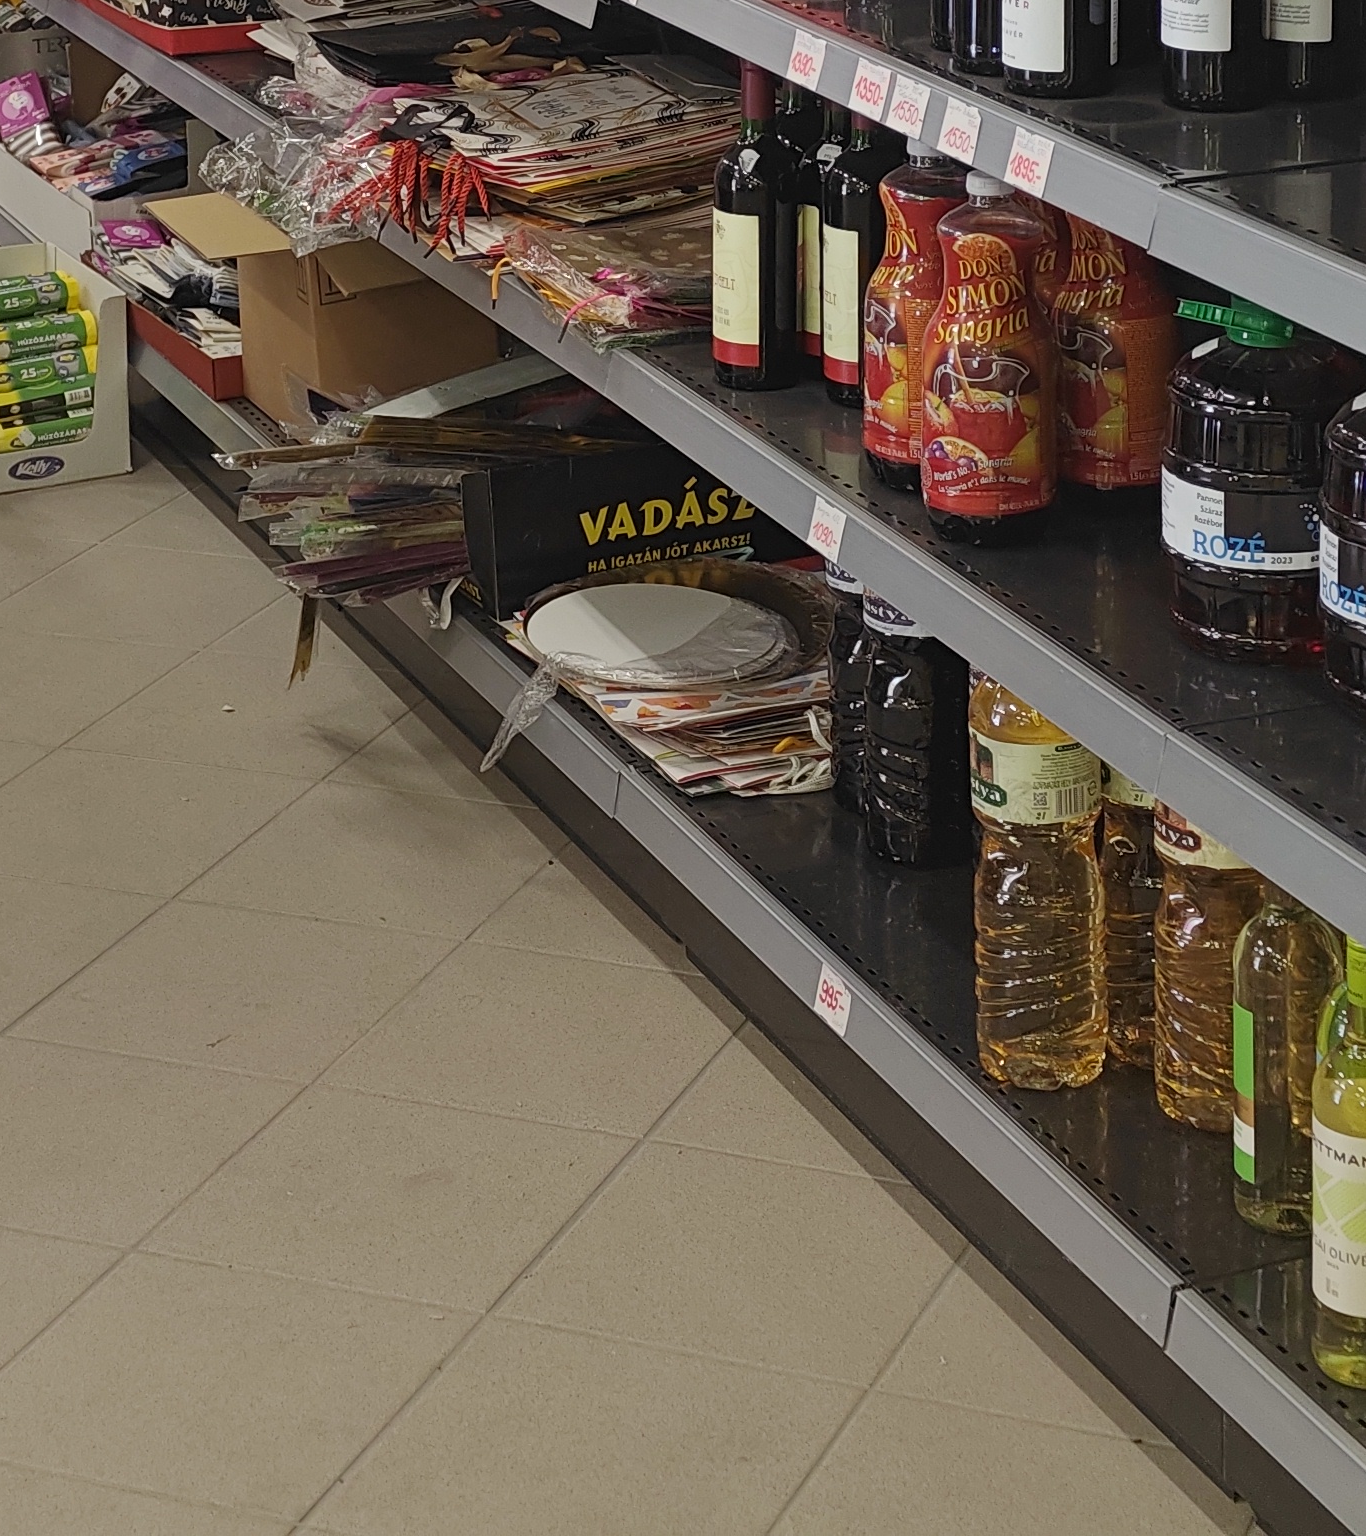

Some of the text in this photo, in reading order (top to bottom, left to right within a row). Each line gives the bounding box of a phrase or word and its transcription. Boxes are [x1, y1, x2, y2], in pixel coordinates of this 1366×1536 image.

[959, 257, 1004, 280] DON
[3, 297, 20, 308] 25
[946, 269, 1027, 316] SIMON
[20, 367, 36, 379] 25
[16, 460, 50, 477] Kelly
[579, 476, 757, 546] VADÁSZ
[587, 532, 752, 574] HA IGAZÁN JÓT AKARSZ!
[1192, 532, 1266, 564] ROZÉ
[1270, 556, 1293, 565] 2023
